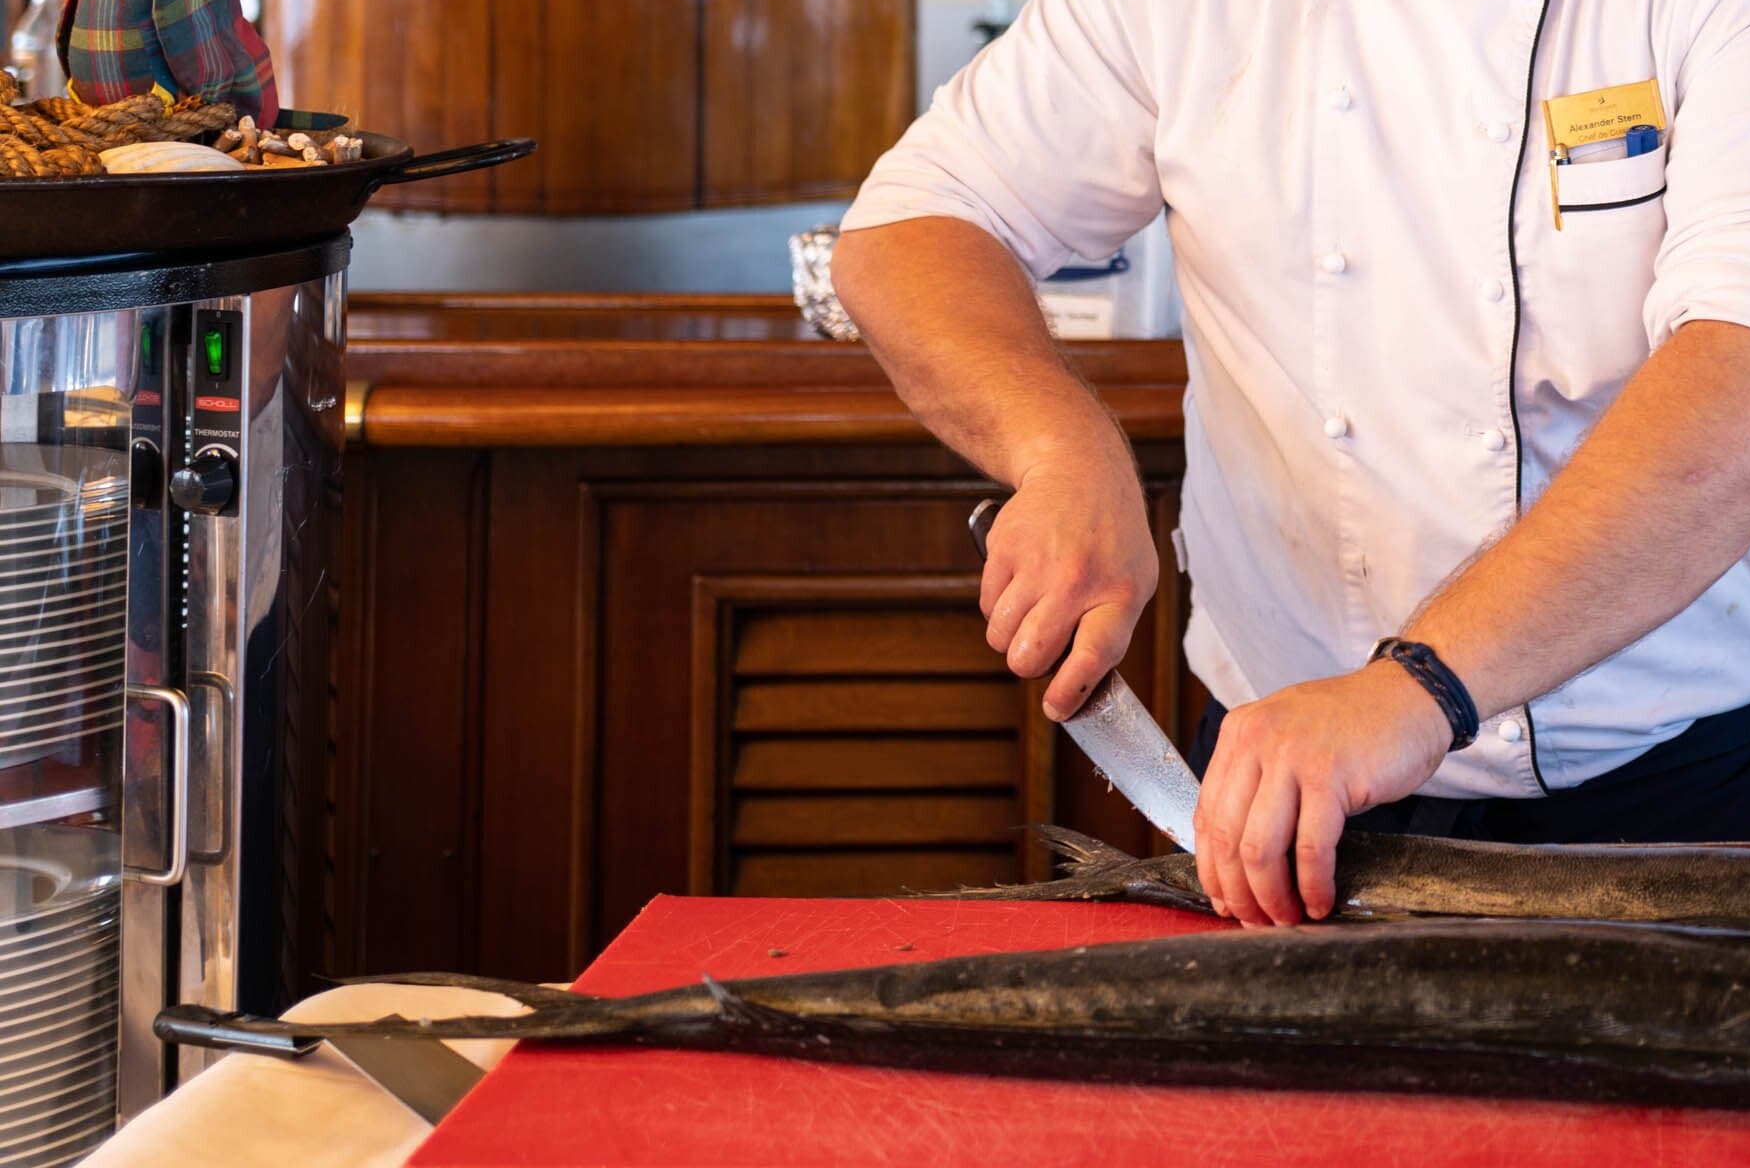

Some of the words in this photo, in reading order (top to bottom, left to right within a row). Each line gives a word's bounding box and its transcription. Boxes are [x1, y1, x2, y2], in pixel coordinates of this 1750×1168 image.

[1570, 118, 1615, 132] Alexander
[1617, 113, 1642, 123] Stern
[194, 428, 240, 439] THERMOSTAT
